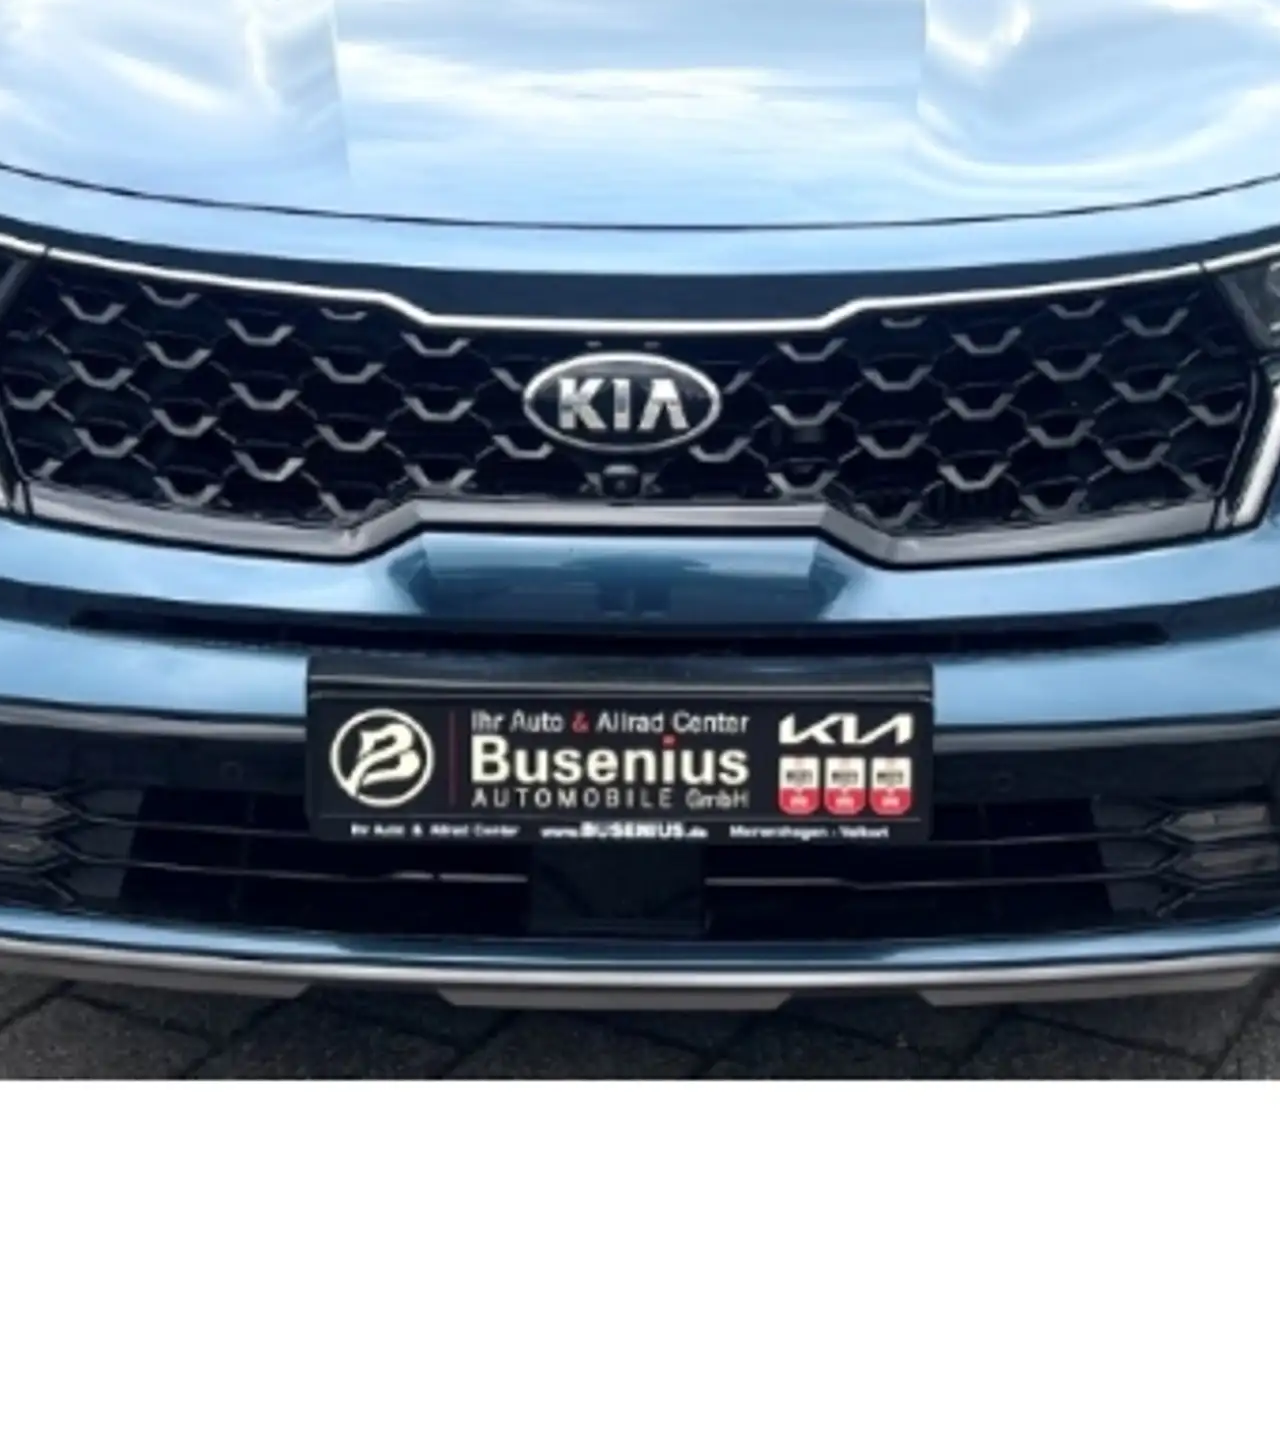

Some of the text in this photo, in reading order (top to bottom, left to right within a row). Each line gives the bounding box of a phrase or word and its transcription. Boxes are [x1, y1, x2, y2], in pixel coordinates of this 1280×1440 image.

[558, 378, 690, 431] KIA
[471, 711, 750, 734] Ihr Auto & Allrad Center
[779, 712, 913, 745] KIA
[470, 733, 750, 785] Busenius
[471, 787, 750, 809] AUTOMOBILE GmbH
